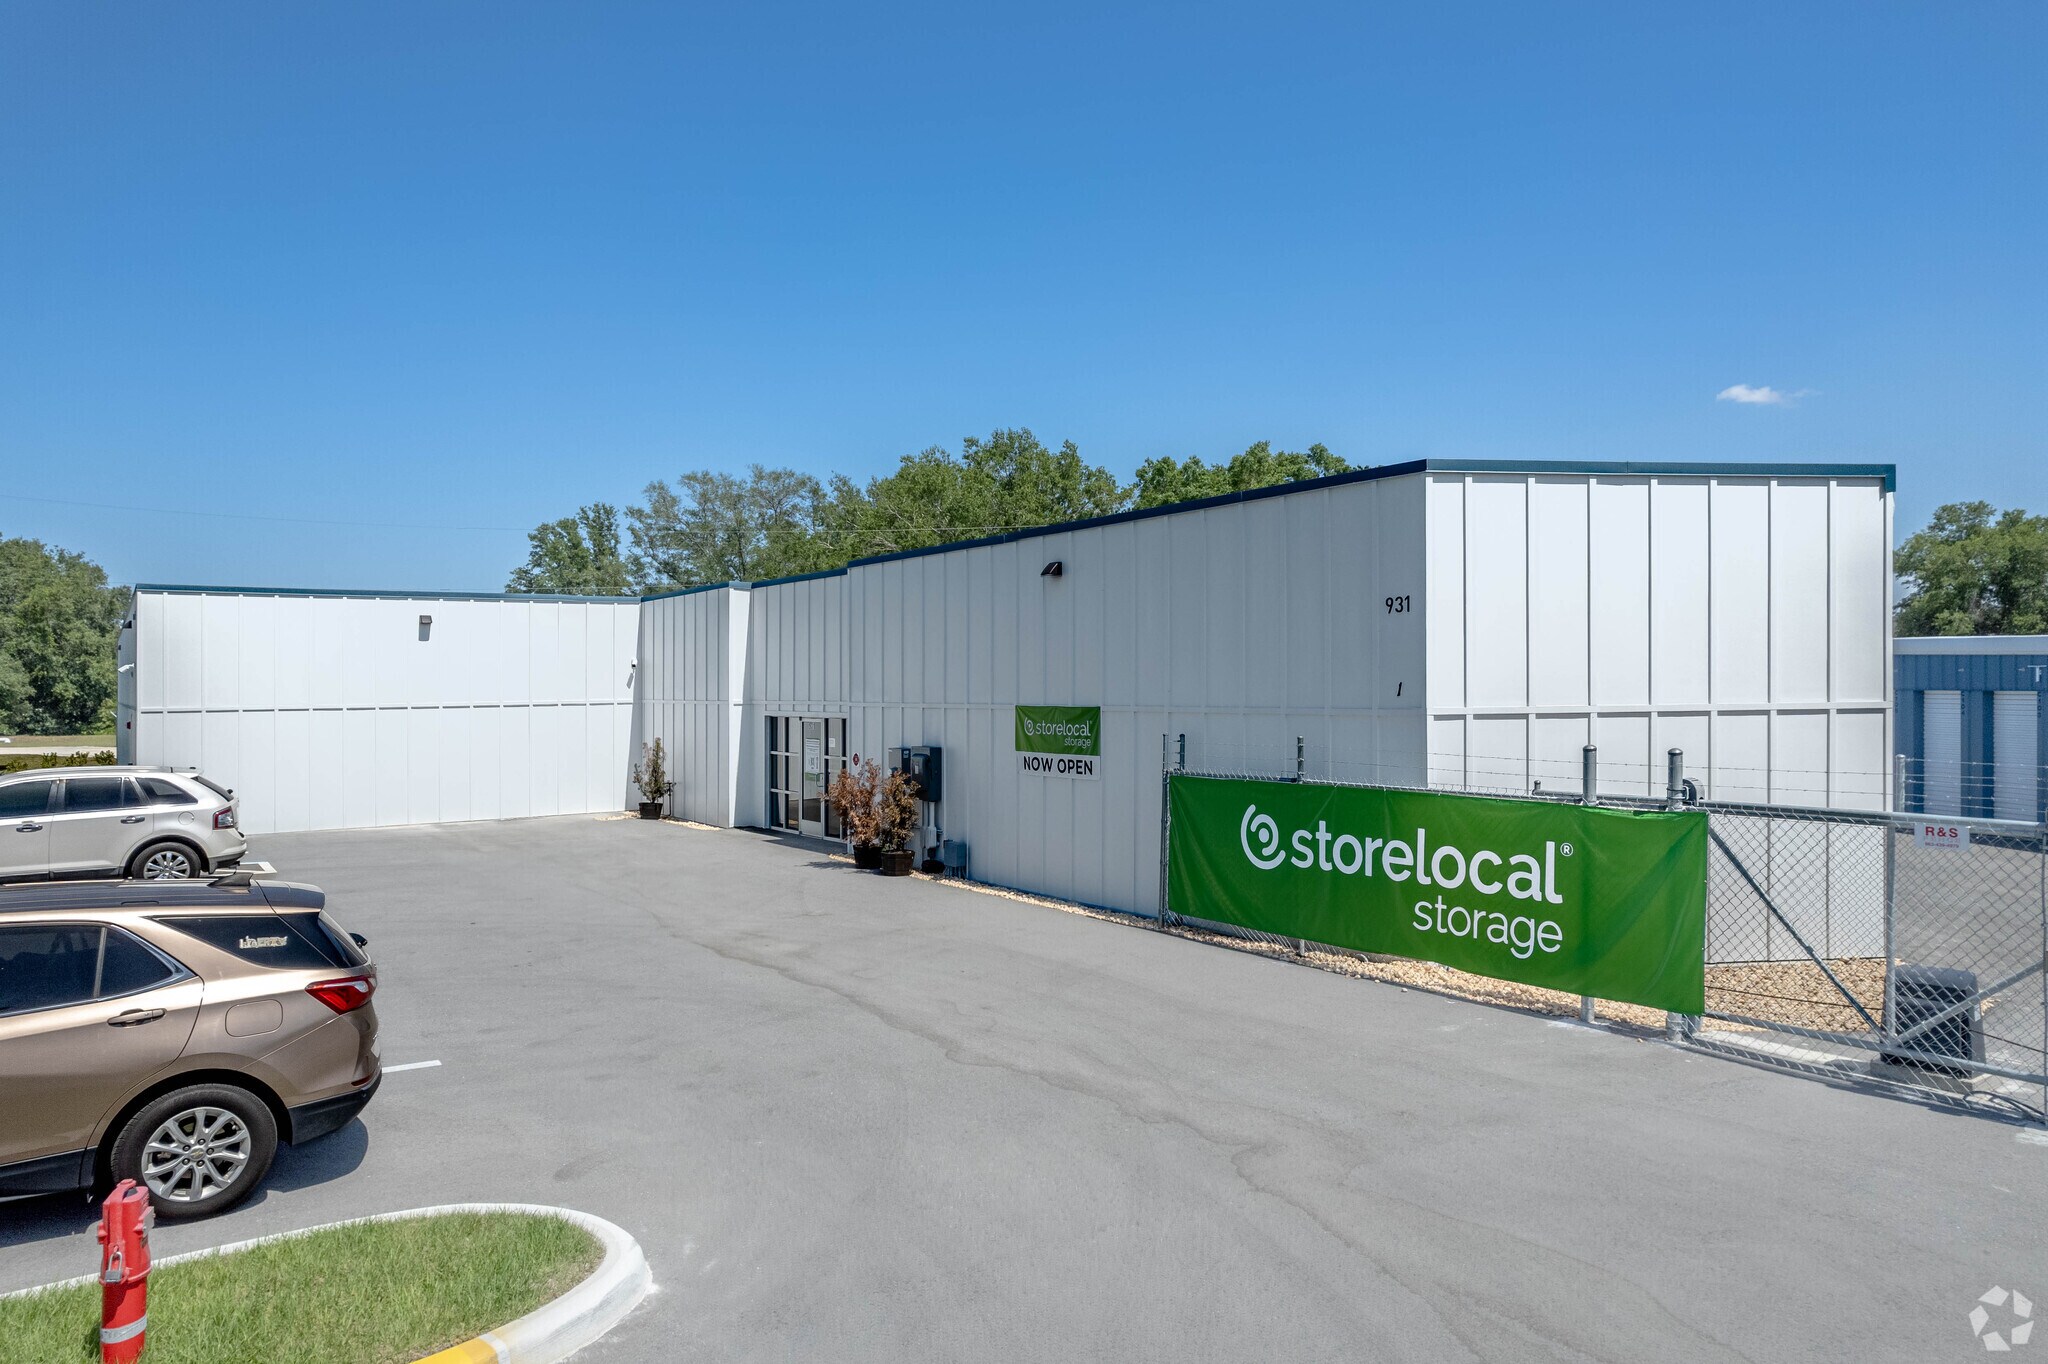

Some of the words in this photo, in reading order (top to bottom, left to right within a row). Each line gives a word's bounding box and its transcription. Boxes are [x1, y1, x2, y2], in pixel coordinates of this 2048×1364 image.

[1385, 595, 1410, 614] 931
[1035, 720, 1091, 736] storelocal
[1064, 737, 1091, 748] storage
[1023, 755, 1053, 772] NOW
[1057, 758, 1093, 775] OPEN
[1412, 895, 1563, 960] storage
